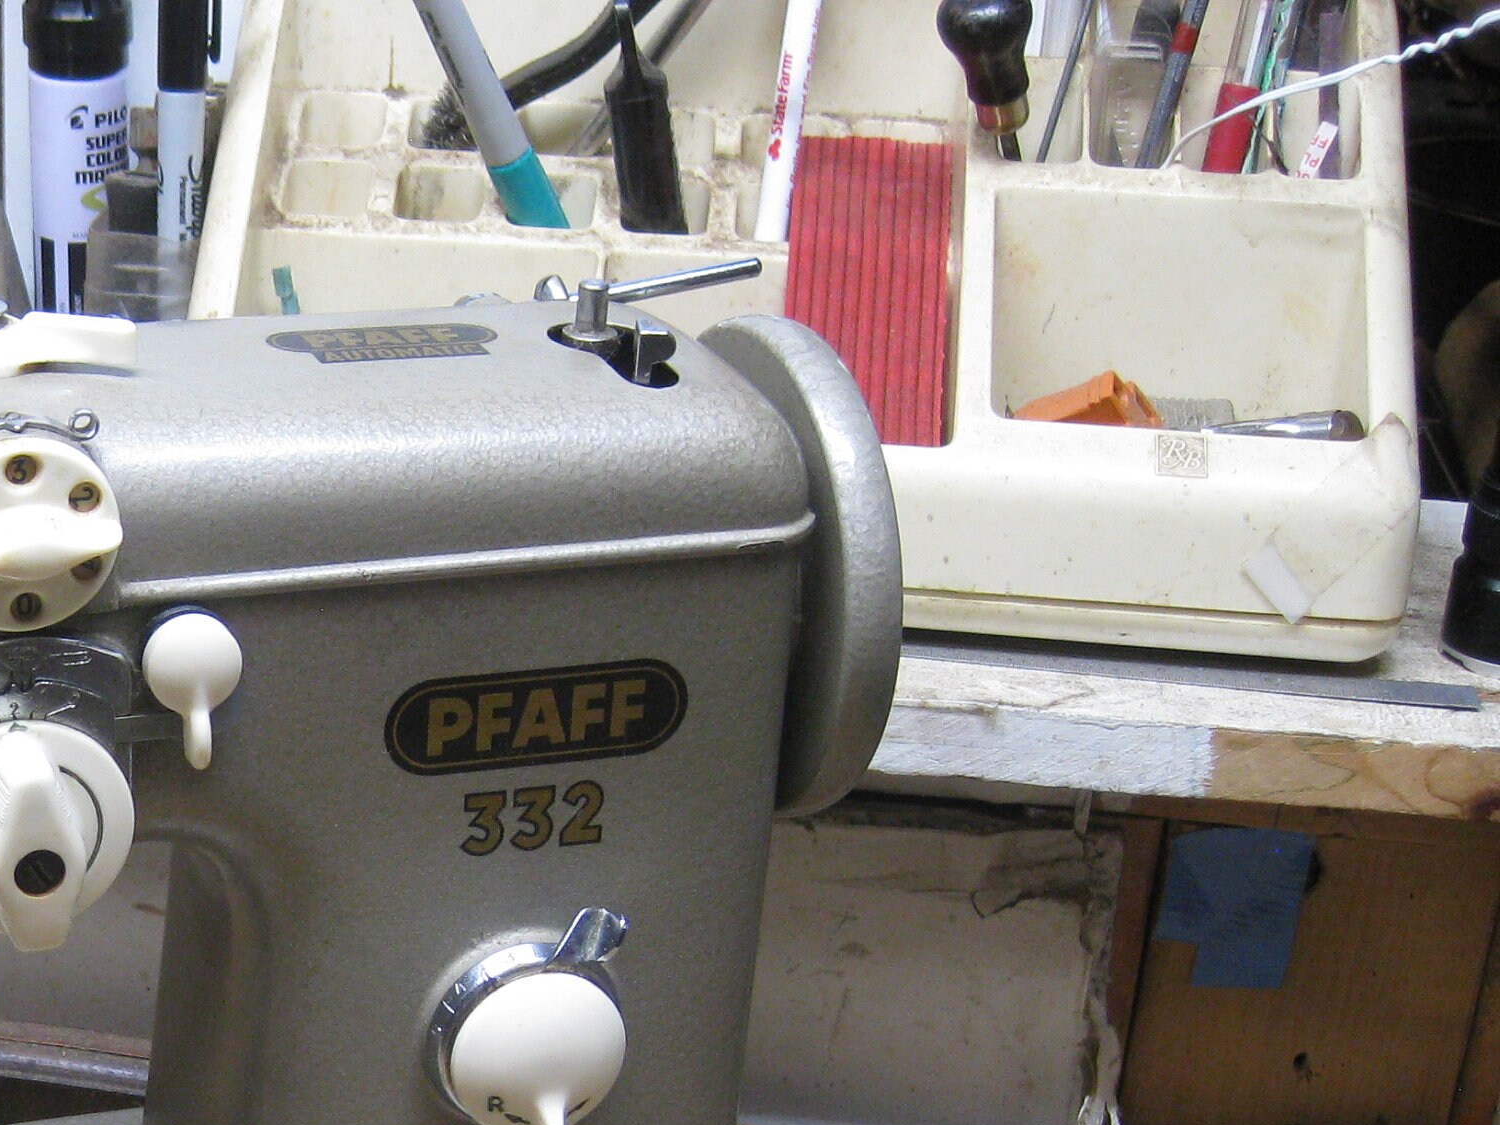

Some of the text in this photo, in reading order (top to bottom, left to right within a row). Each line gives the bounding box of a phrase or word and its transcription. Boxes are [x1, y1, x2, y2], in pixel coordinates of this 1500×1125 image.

[95, 105, 128, 128] PILO
[301, 326, 460, 349] PFAFF
[324, 343, 483, 363] AUTOMATIC
[13, 457, 30, 482] 3
[426, 679, 647, 758] PFAFF
[460, 779, 605, 858] 332
[488, 1096, 506, 1113] R
